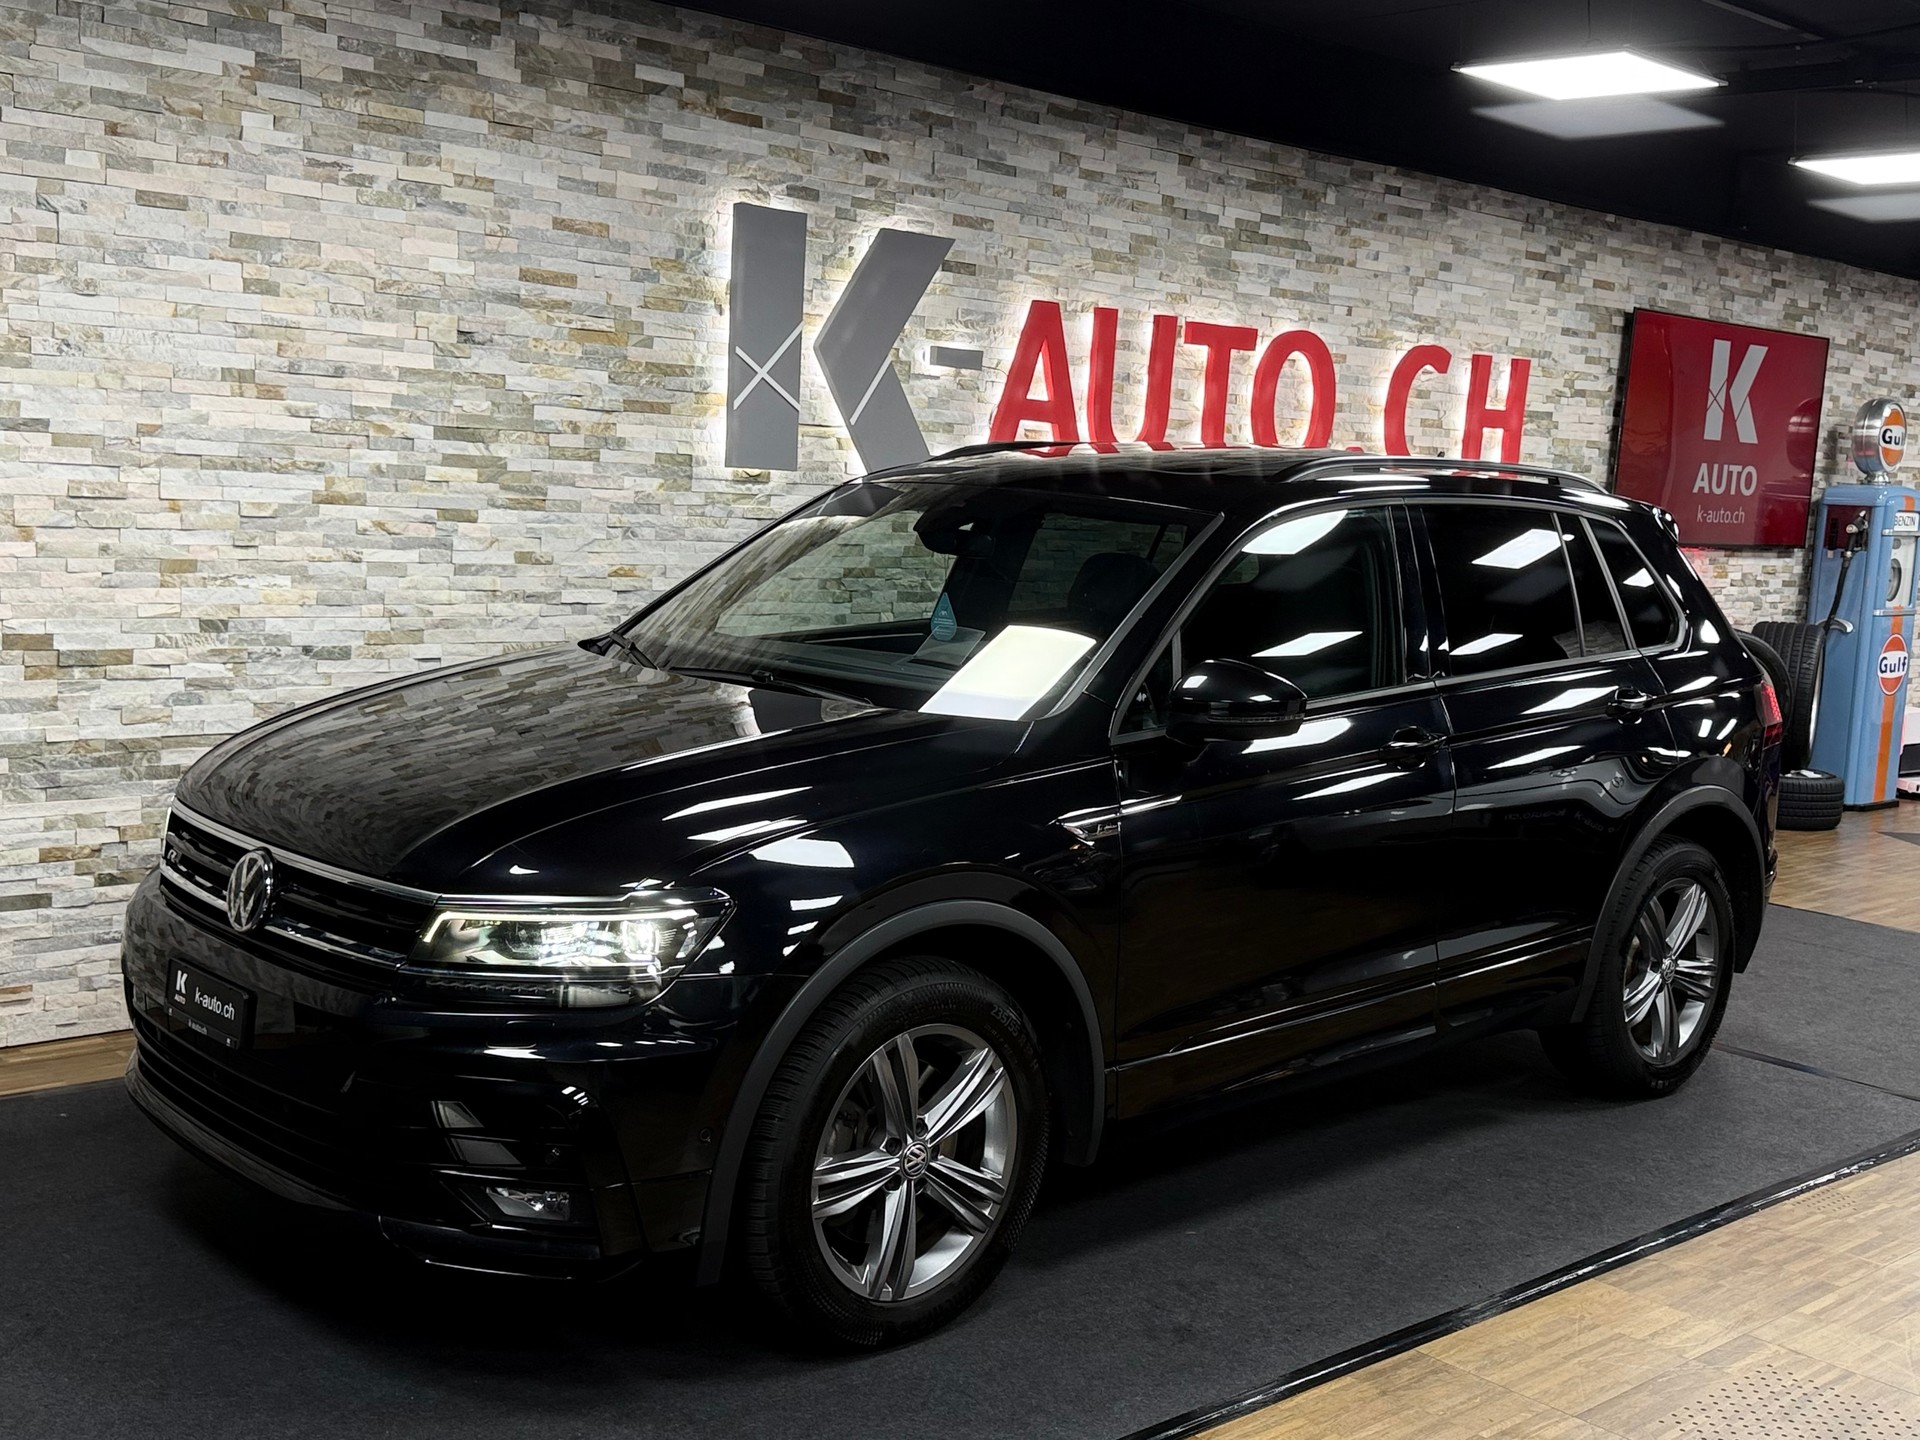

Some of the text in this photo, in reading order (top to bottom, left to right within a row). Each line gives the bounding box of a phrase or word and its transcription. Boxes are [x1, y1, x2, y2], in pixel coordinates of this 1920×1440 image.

[1703, 338, 1769, 444] K
[1692, 462, 1758, 497] AUTO
[1696, 504, 1746, 524] k-auto.ch
[1879, 656, 1907, 674] Gulf
[176, 969, 188, 995] K
[194, 986, 236, 1021] k-auto.ch
